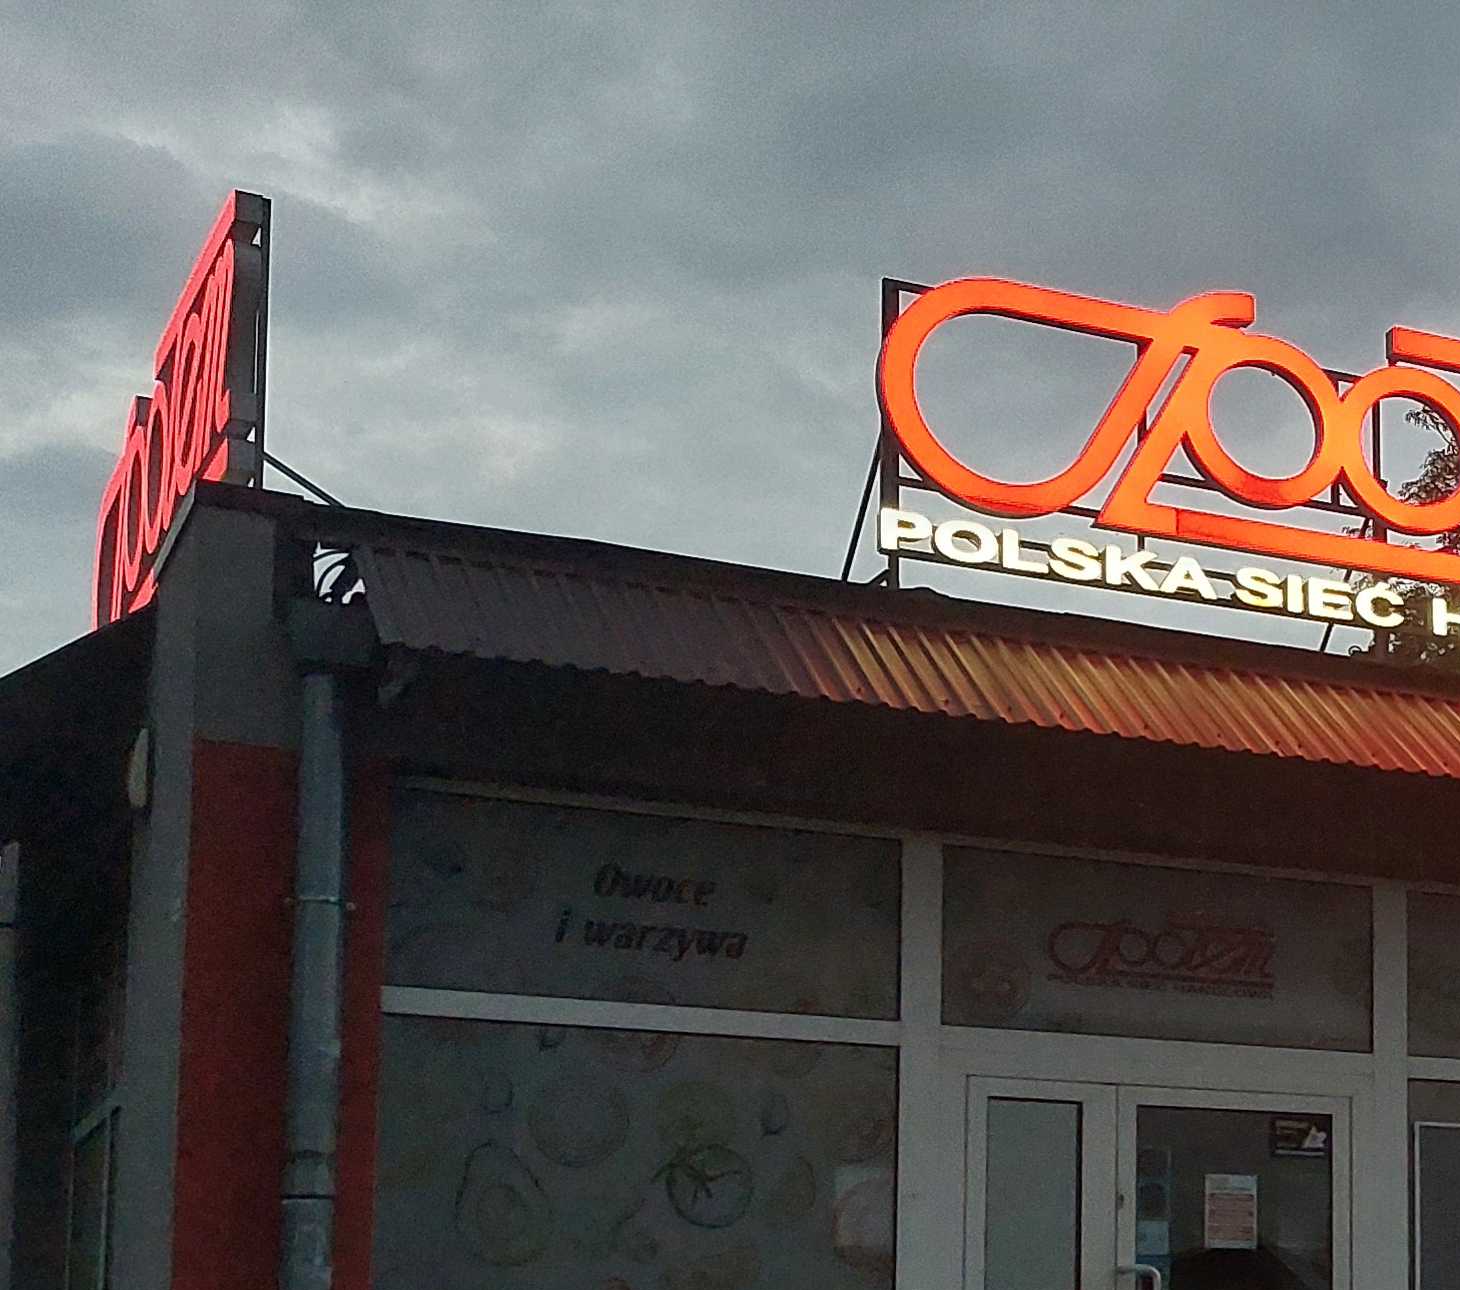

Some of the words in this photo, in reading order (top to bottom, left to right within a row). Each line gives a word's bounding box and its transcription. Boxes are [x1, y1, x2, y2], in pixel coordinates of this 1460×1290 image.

[878, 509, 1217, 600] POLSKA
[1236, 571, 1405, 629] SIEĆ
[594, 861, 716, 906] Owoce
[554, 906, 571, 943] i
[584, 917, 748, 961] warzywa
